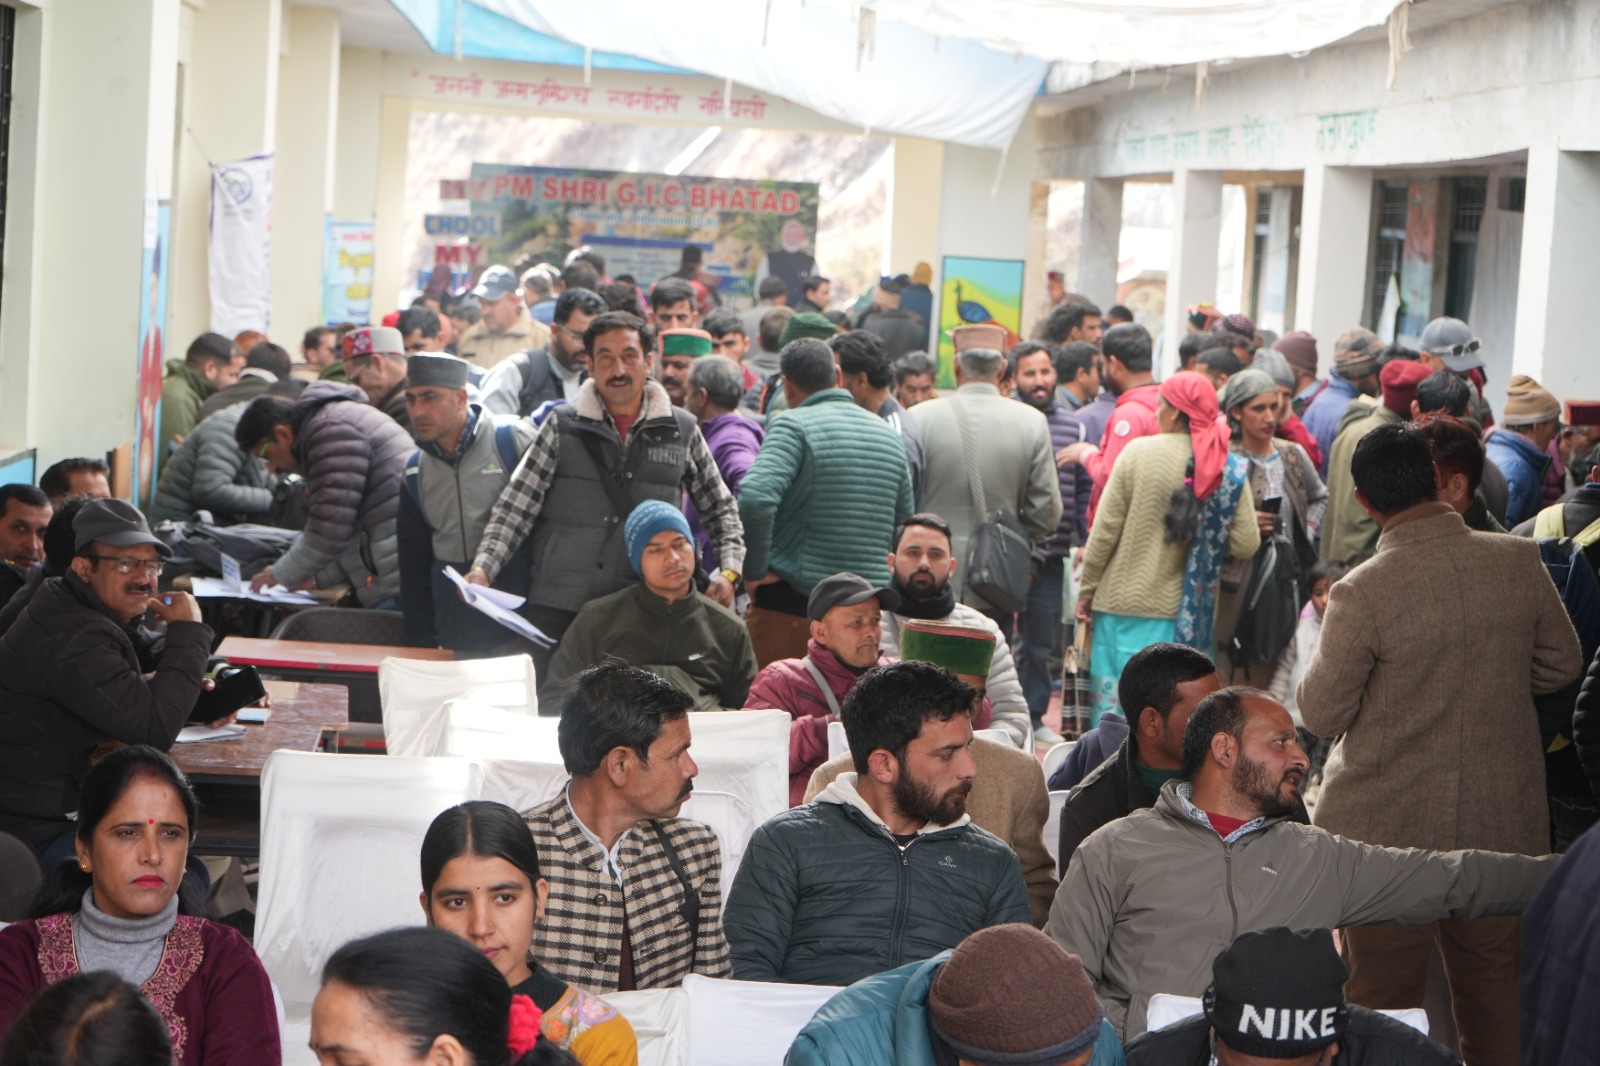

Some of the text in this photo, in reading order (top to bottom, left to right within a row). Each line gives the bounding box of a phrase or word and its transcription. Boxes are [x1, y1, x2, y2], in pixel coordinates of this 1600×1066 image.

[494, 174, 800, 215] PM SHRI G.I.C BHATAD
[435, 244, 483, 264] MY
[1238, 1003, 1338, 1041] NIKE
